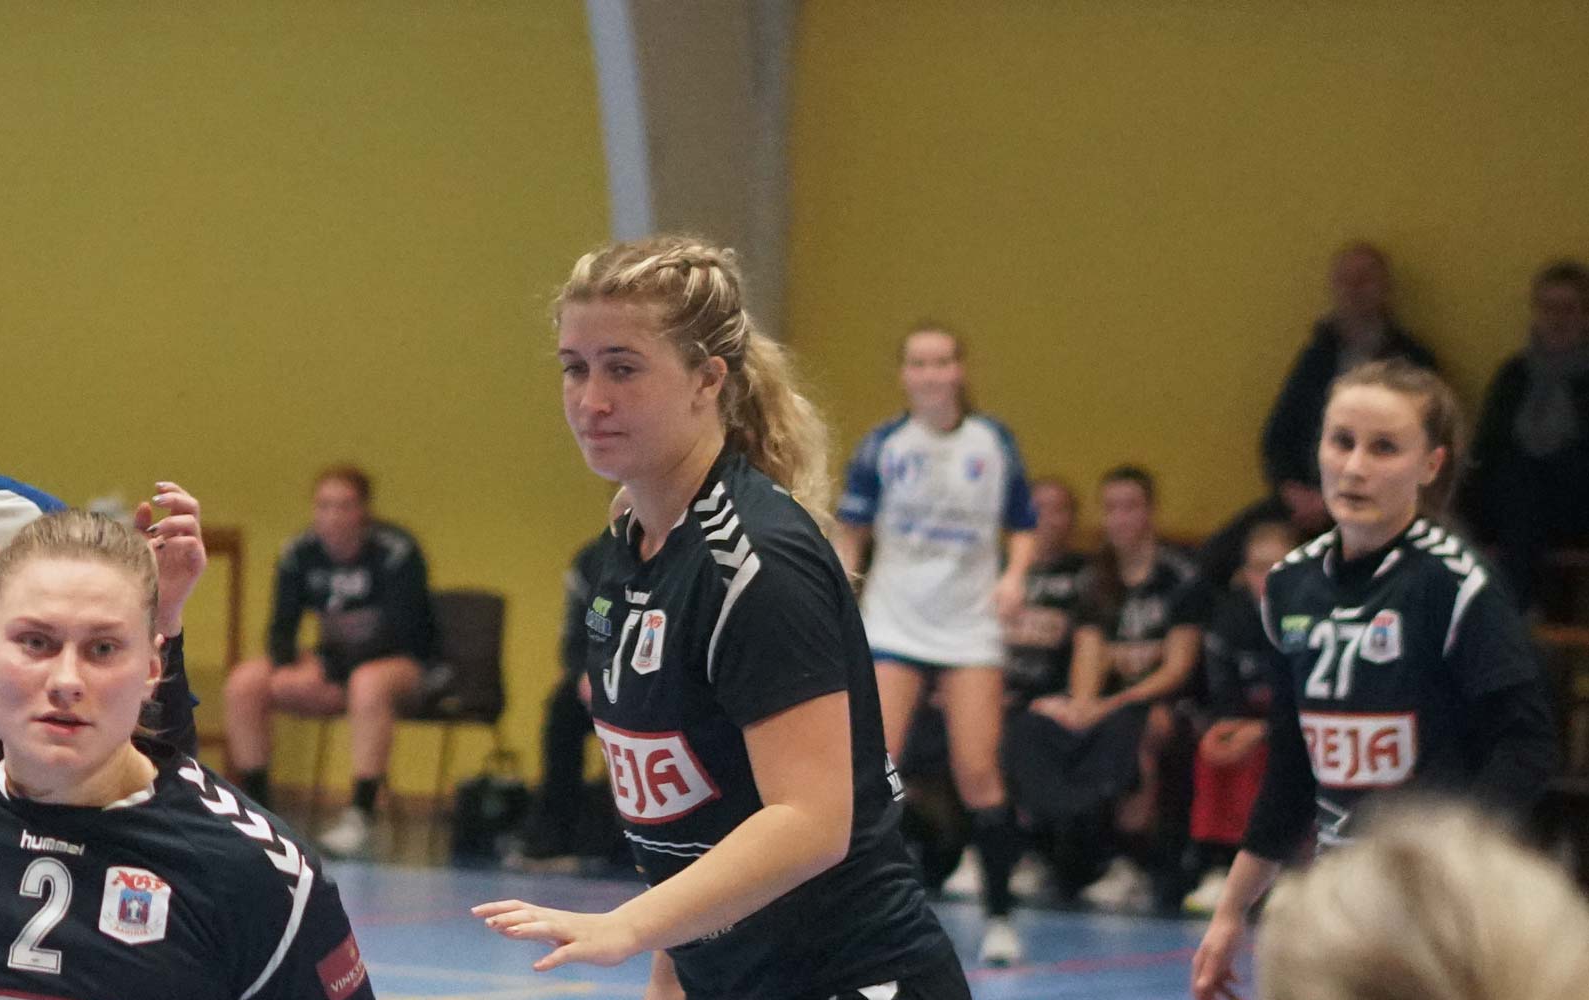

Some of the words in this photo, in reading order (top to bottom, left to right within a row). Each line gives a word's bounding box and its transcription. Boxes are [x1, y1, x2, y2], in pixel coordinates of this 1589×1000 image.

[1304, 620, 1366, 699] 27
[602, 740, 692, 815] EJA
[19, 829, 86, 856] hummel
[7, 856, 73, 975] 2
